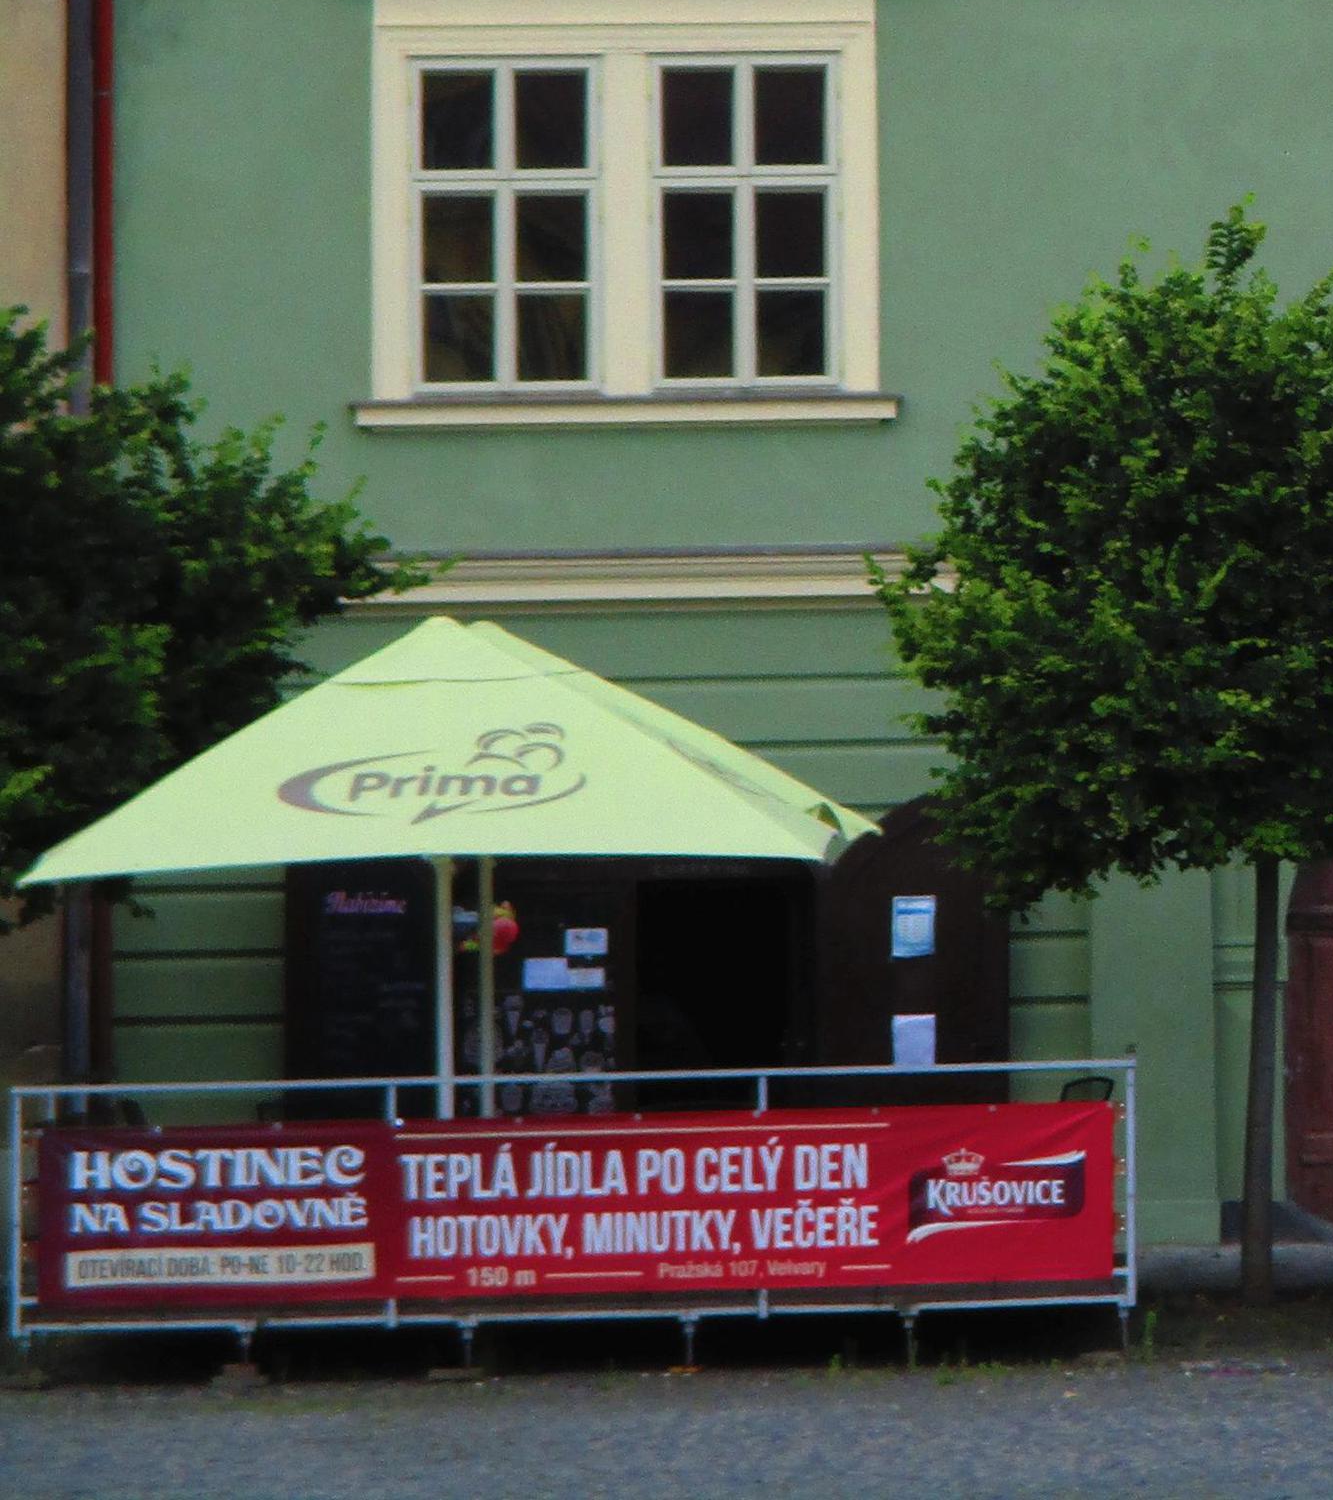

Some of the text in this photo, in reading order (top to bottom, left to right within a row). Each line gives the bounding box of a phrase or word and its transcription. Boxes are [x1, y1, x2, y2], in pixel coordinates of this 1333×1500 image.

[348, 765, 542, 802] Prima
[67, 1145, 367, 1192] HOSTINEC
[398, 1136, 868, 1199] TEPLÁ JÍDLA PO CELÝ DEN
[68, 1192, 369, 1235] NA SLADOVNĚ
[409, 1198, 880, 1260] HOTOVKY, MINUTKY, VEČEŘE
[78, 1253, 164, 1280] OTEVÍRACÍ
[219, 1255, 269, 1276] PO-NE
[514, 1269, 537, 1286] m
[658, 1261, 723, 1279] Pražská
